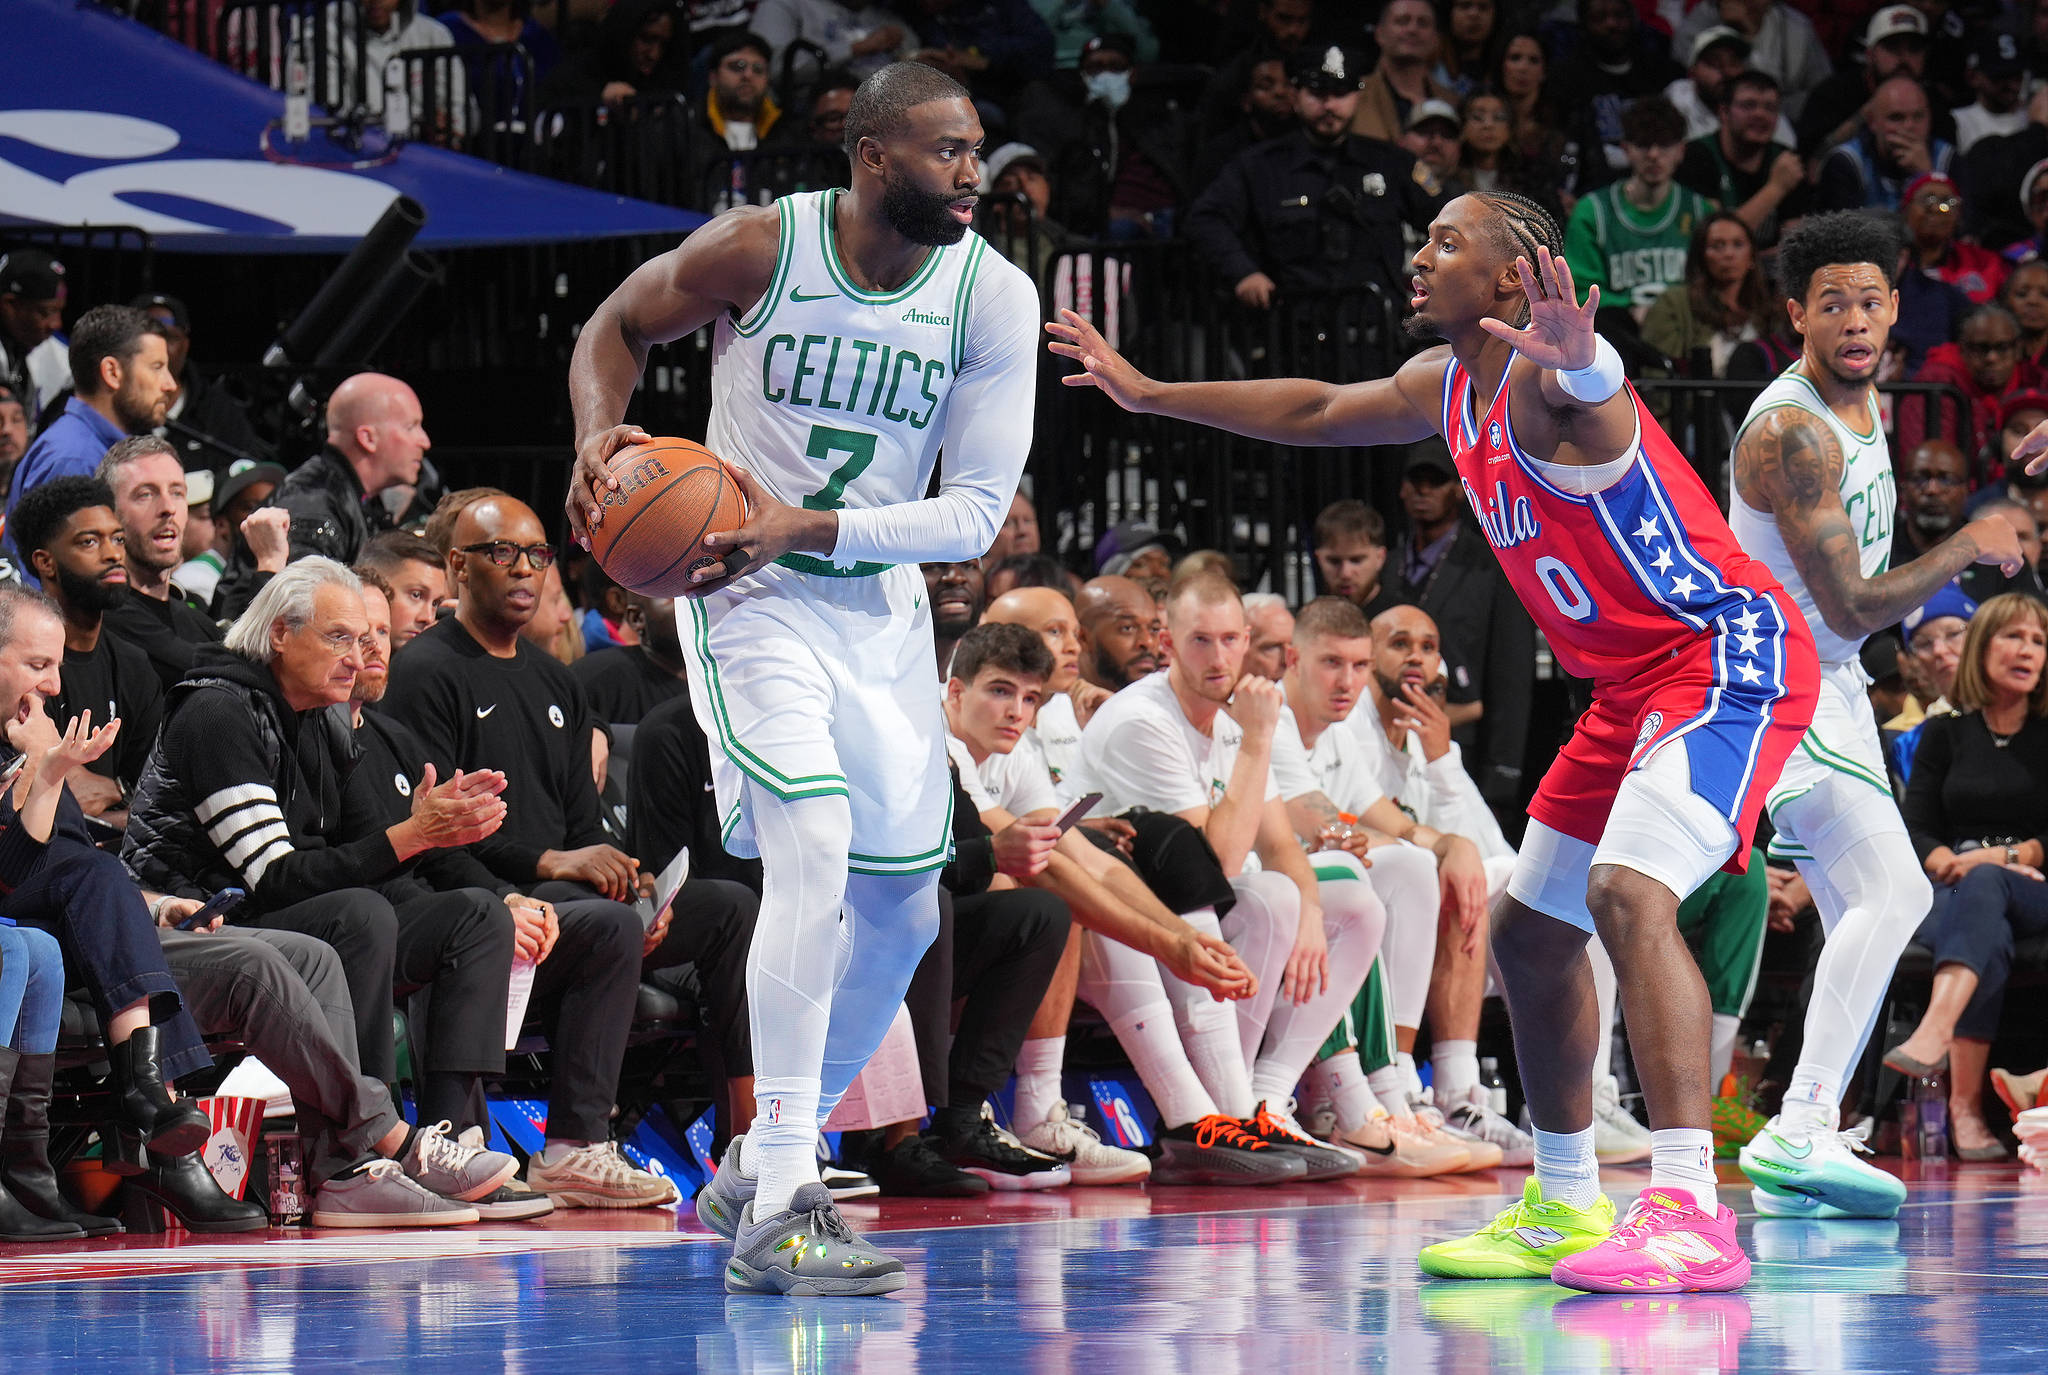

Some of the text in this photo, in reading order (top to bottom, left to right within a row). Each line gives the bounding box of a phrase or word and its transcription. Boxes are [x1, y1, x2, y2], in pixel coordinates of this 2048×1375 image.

[901, 307, 950, 327] Amica
[763, 333, 946, 430] CELTICS
[802, 424, 879, 512] 7
[1487, 452, 1511, 465] crypto.com
[1462, 476, 1542, 551] Phila
[1536, 555, 1599, 625] 0
